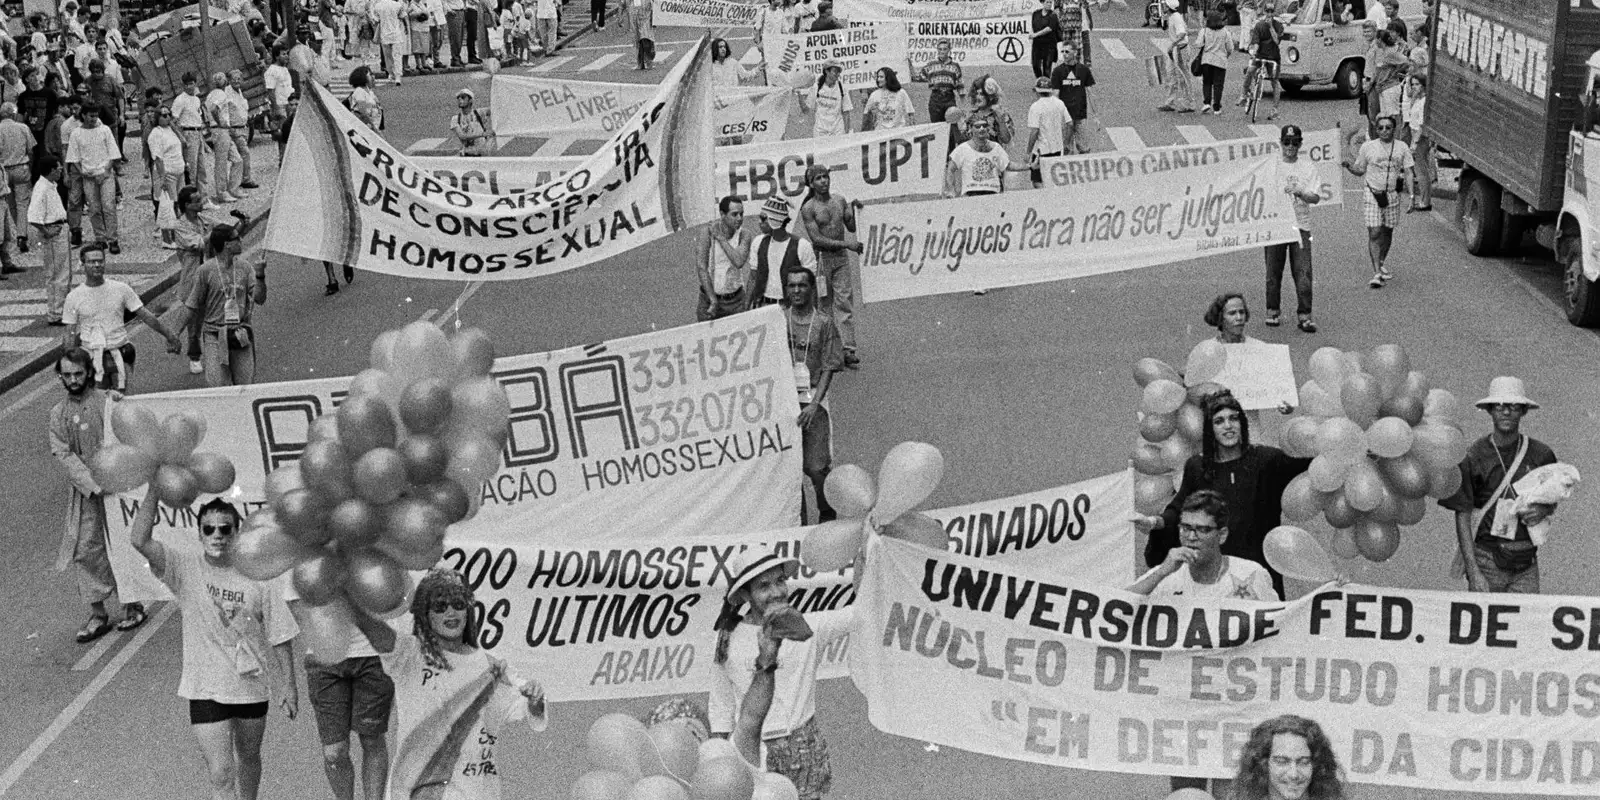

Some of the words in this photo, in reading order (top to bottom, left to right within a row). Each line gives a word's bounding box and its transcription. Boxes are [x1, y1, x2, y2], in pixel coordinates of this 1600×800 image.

[660, 1, 723, 17] CONSIDERADA
[726, 6, 758, 20] COMO
[985, 20, 1030, 35] SEXUAL
[778, 39, 800, 73] ANUS
[804, 50, 811, 61] E
[814, 49, 828, 60] OS
[832, 44, 877, 58] GRUPOS
[806, 32, 843, 47] APOIA:
[1436, 2, 1549, 100] PONTOFORTE
[528, 84, 576, 112] PELA
[565, 89, 618, 123] LIVRE
[722, 116, 768, 134] CES/RS
[344, 128, 473, 208] GRUPO
[488, 168, 592, 211] ARCO
[861, 133, 936, 185] UPT
[1049, 156, 1135, 187] GRUPO
[359, 171, 401, 218] DE
[369, 202, 658, 275] HOMOSSEXUAL
[863, 221, 914, 266] Não
[909, 216, 1013, 276] julgueis
[1019, 206, 1076, 250] Para
[1080, 203, 1126, 243] não
[1129, 202, 1172, 237] ser
[1167, 174, 1279, 240] julgado...
[628, 323, 768, 394] 331-1527
[634, 376, 776, 447] 332-0787
[581, 422, 794, 492] HOMOSSEXUAL
[526, 593, 702, 648] ULTIMOS
[920, 558, 1287, 649] UNIVERSIDADE
[1309, 591, 1425, 643] FED.
[1448, 602, 1521, 649] DE
[590, 644, 696, 686] ABAIXO
[1093, 646, 1162, 696] DE
[1189, 655, 1399, 708] ESTUDO
[1350, 728, 1418, 777] DA
